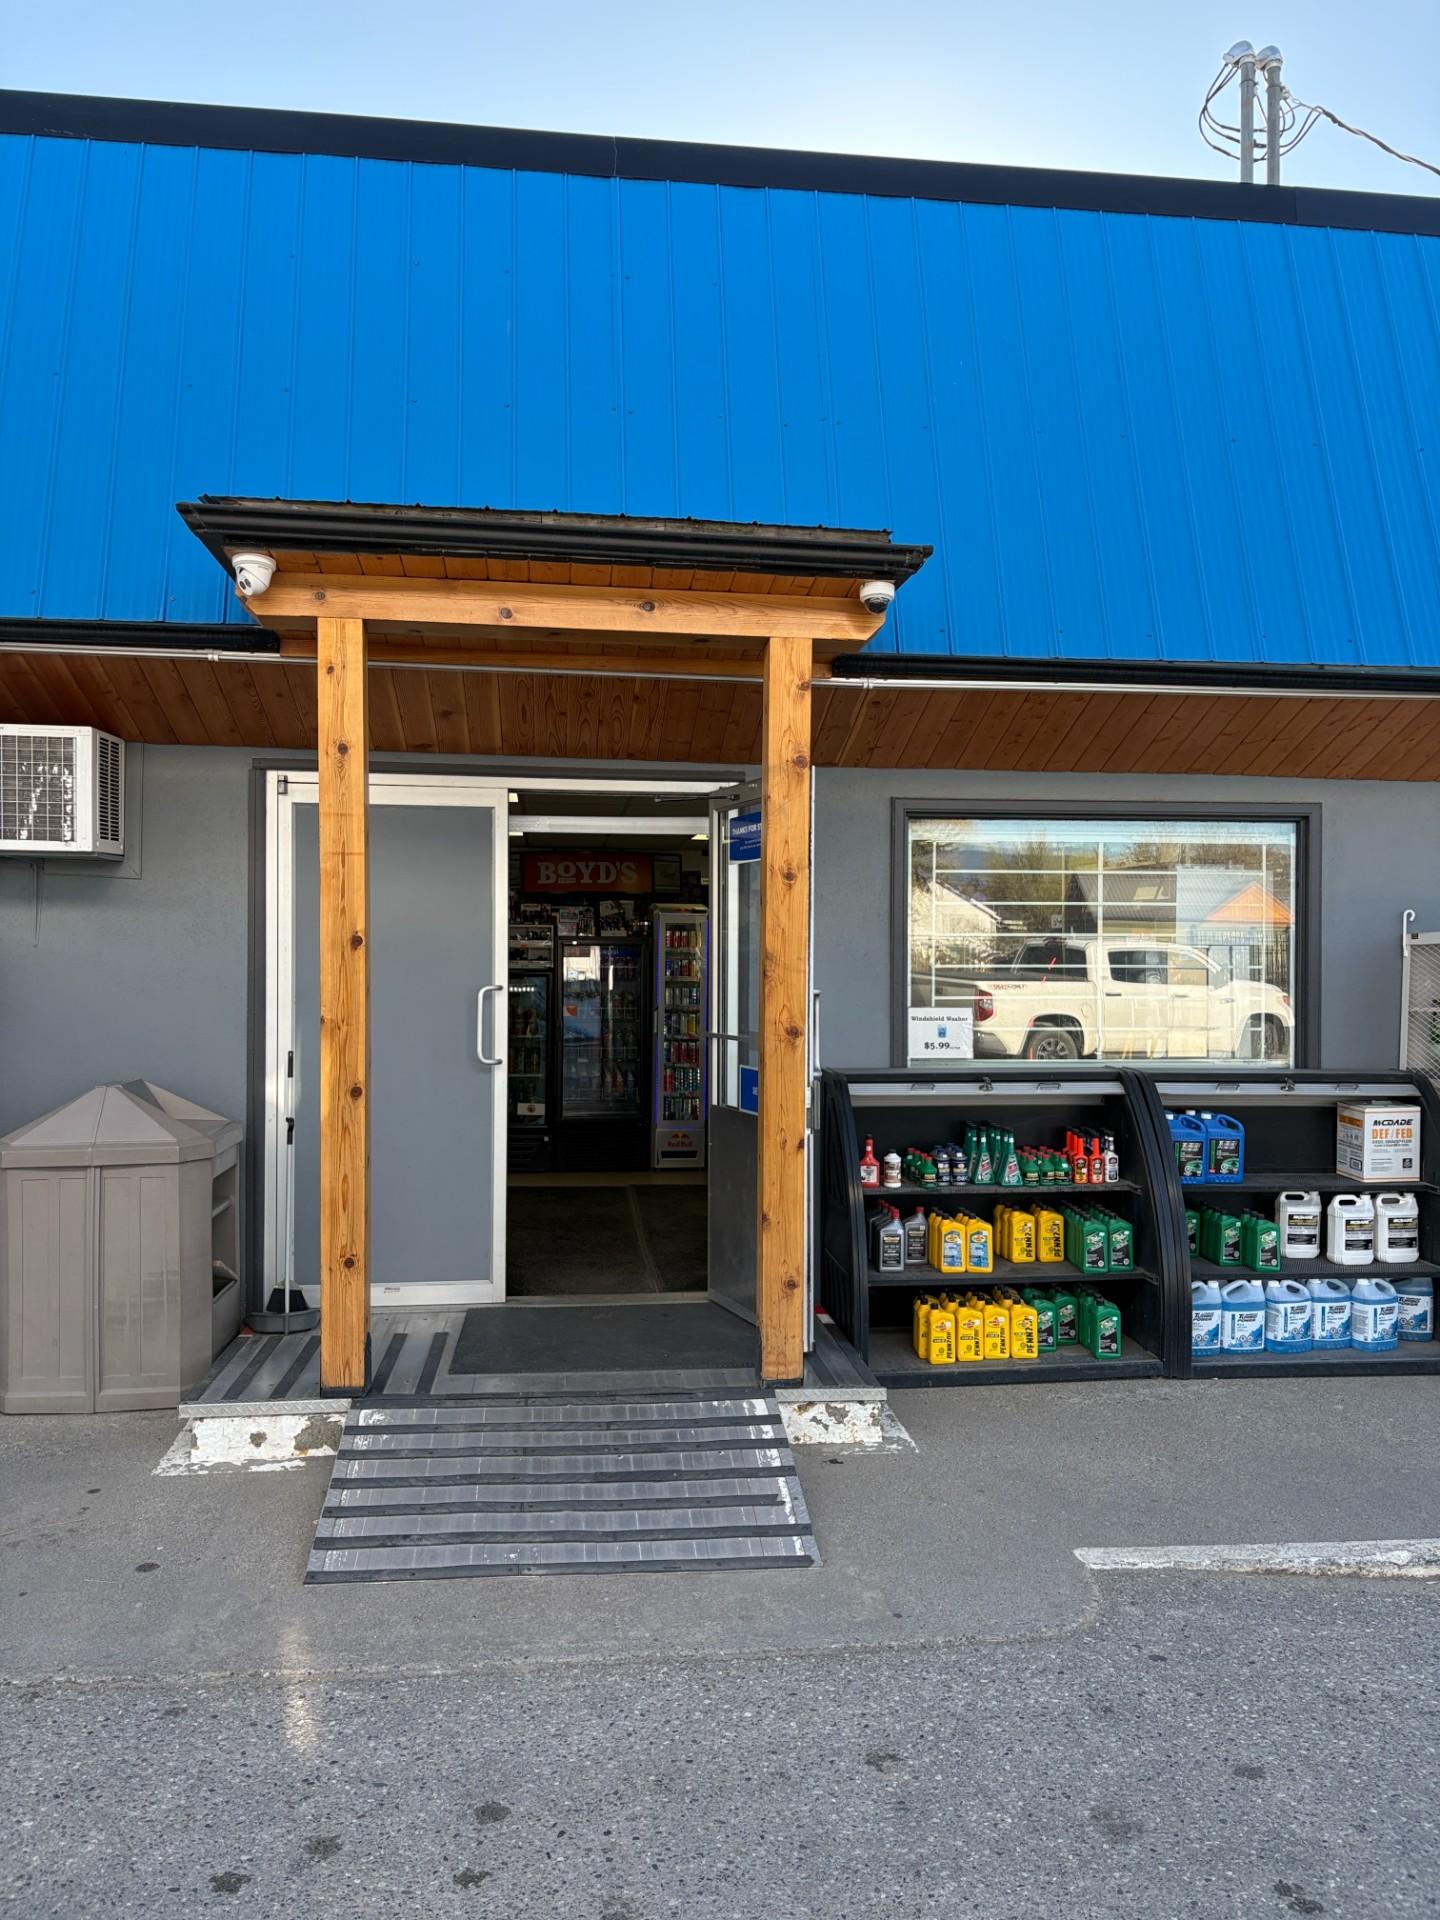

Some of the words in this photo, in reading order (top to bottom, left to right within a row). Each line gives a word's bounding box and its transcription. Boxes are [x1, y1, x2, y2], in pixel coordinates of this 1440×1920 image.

[732, 825, 747, 835] THANKS
[537, 861, 638, 884] BOYD'S
[924, 1041, 950, 1050] $5.99
[1372, 1128, 1389, 1139] DEF
[1396, 1128, 1412, 1138] FED
